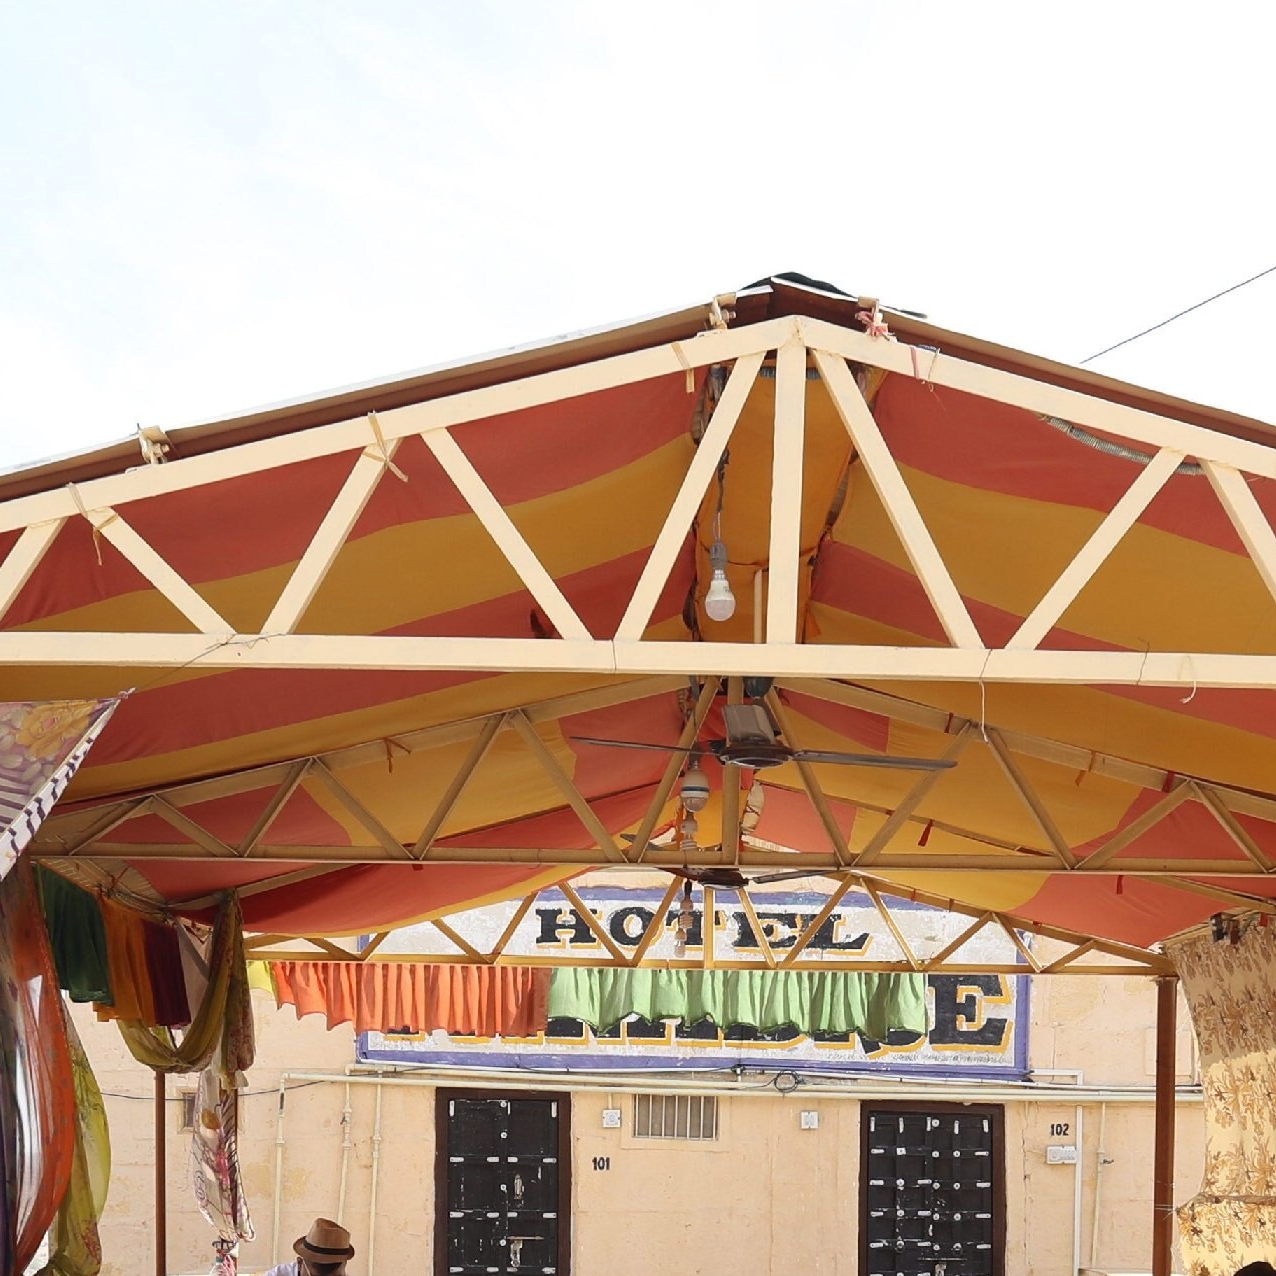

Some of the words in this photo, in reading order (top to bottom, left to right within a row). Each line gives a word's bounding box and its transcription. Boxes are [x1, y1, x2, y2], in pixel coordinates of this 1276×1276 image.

[535, 907, 873, 954] HOTEL
[1050, 1123, 1069, 1136] 102
[592, 1157, 610, 1170] 101
